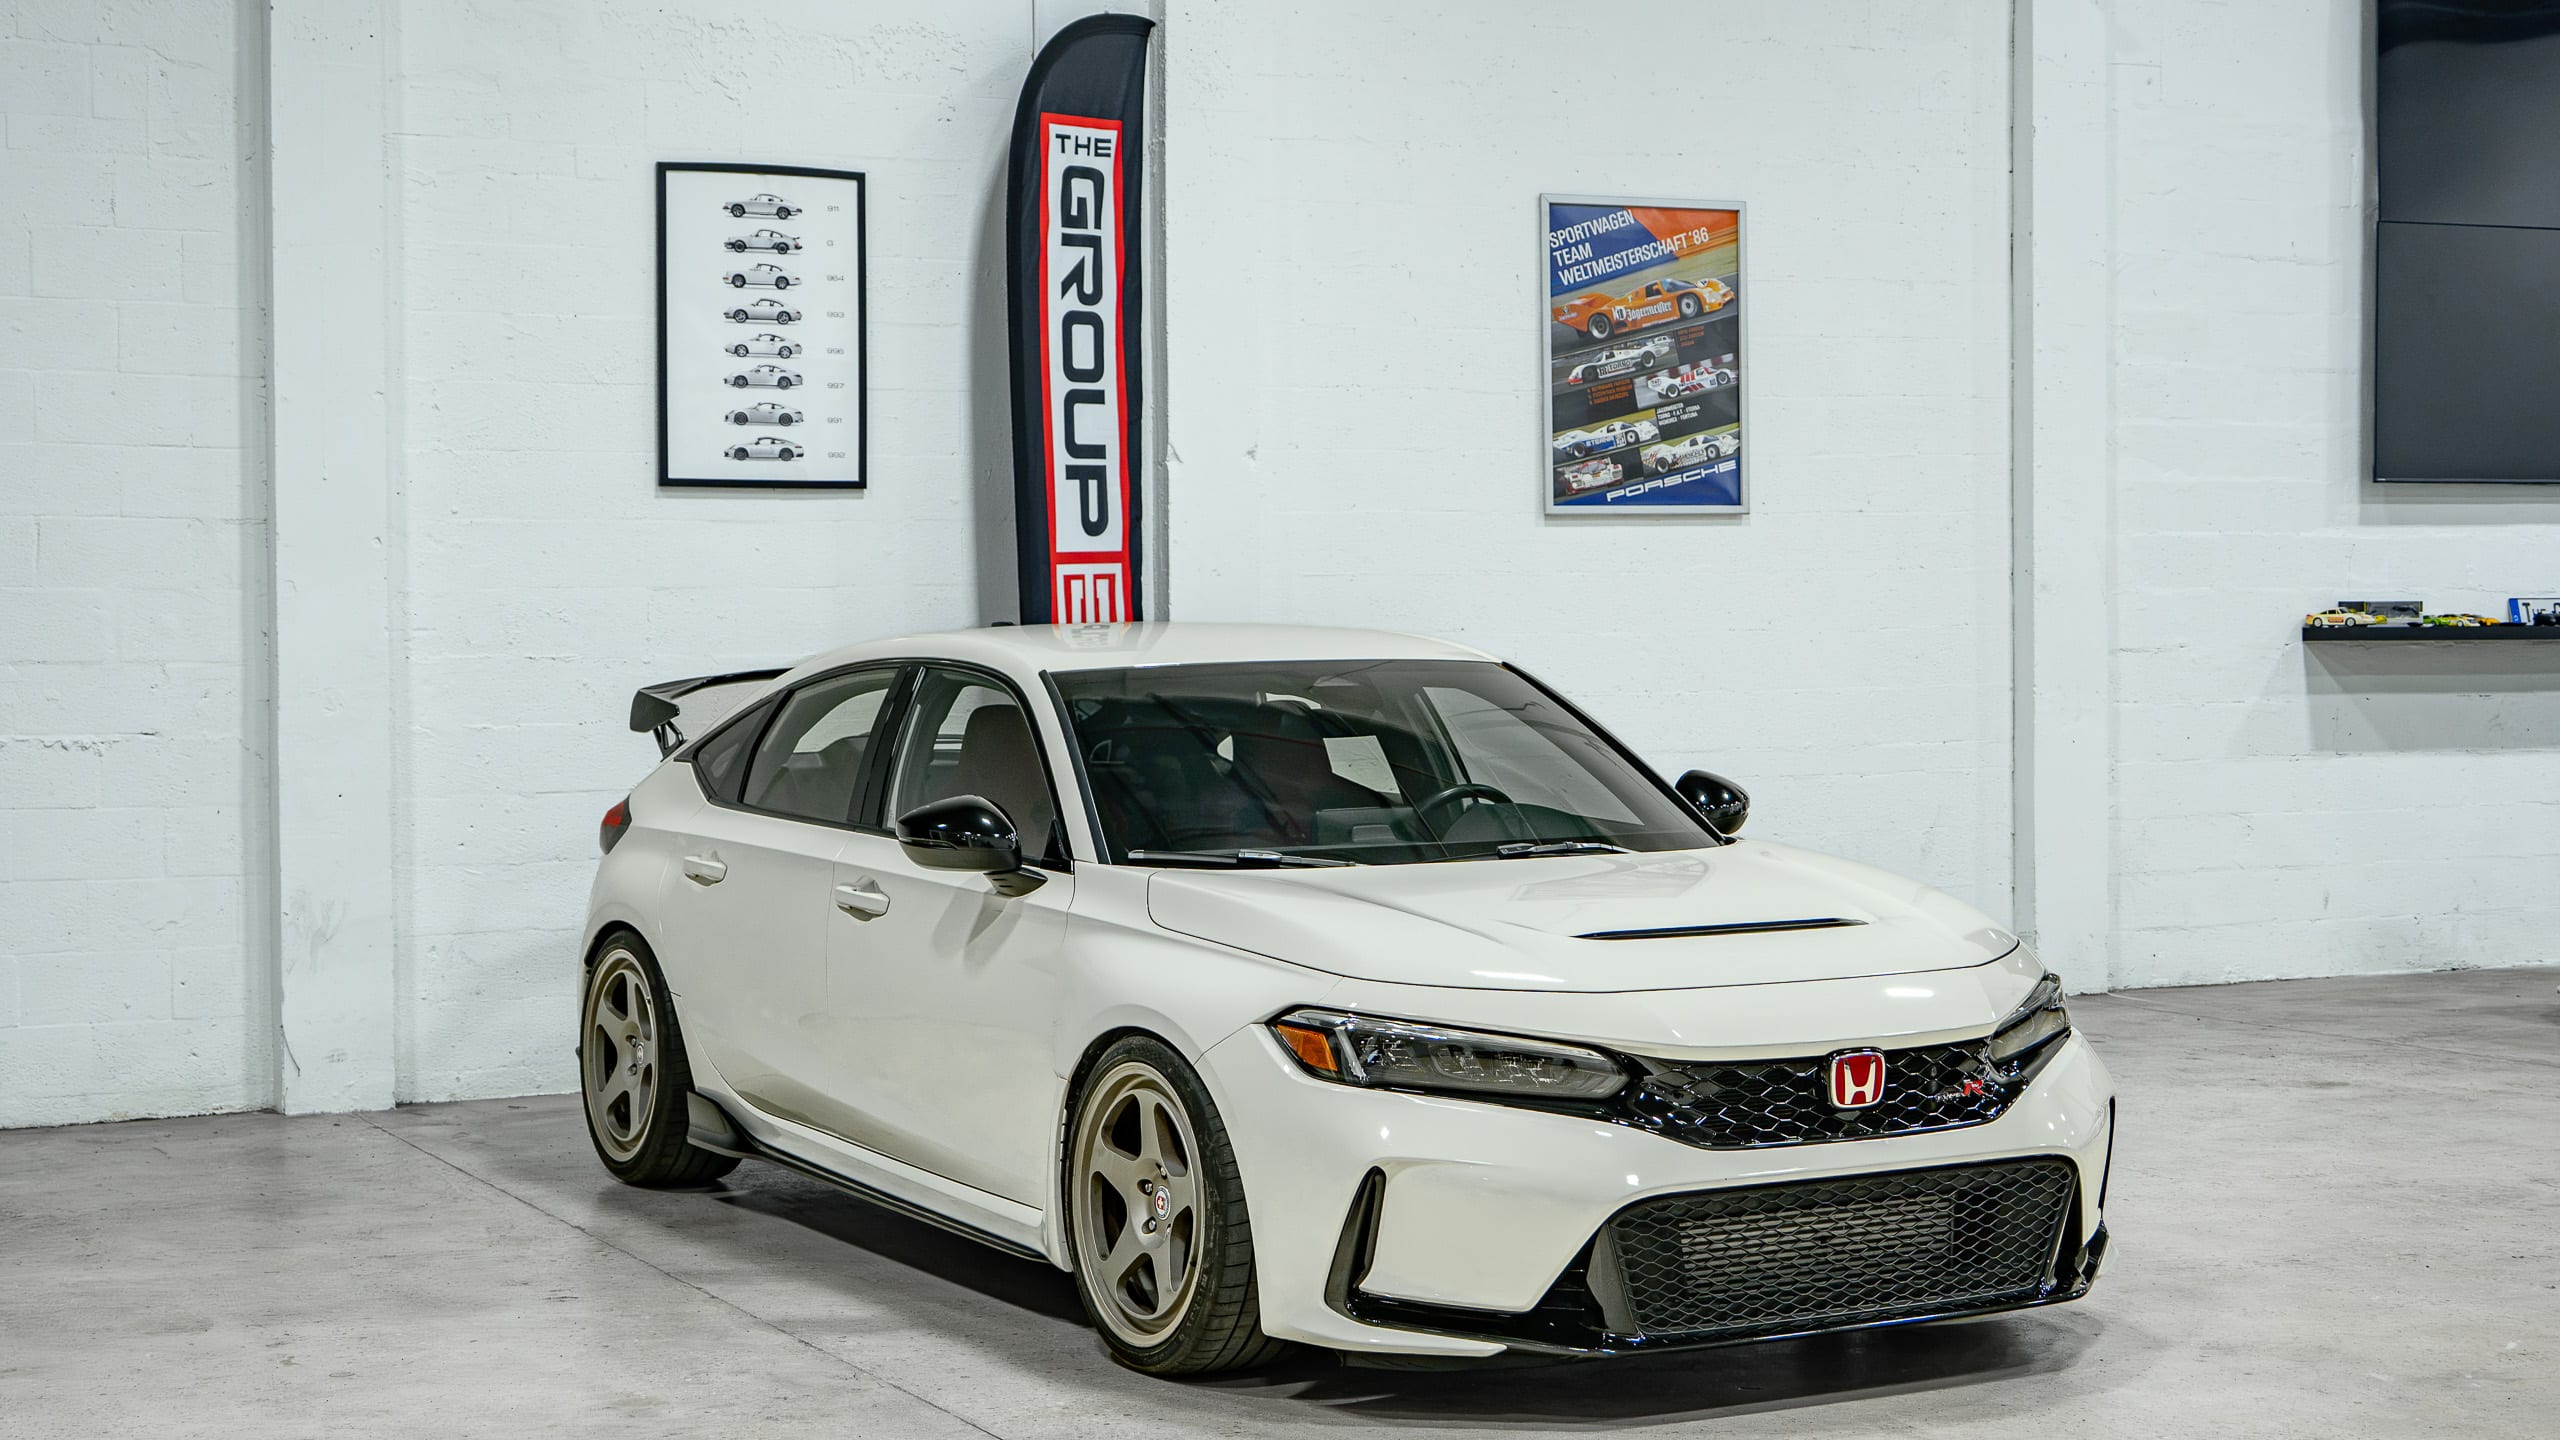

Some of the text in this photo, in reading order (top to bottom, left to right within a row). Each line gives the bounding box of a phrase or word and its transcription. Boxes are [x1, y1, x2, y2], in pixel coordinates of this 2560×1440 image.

[1055, 133, 1112, 158] THE
[1549, 209, 1635, 248] SPORTWAGEN
[1552, 242, 1593, 267] TEAM
[1557, 232, 1687, 286] WELTMEISTERSCHAFT
[1060, 165, 1109, 537] GROUP
[1606, 460, 1737, 502] PORSCHE
